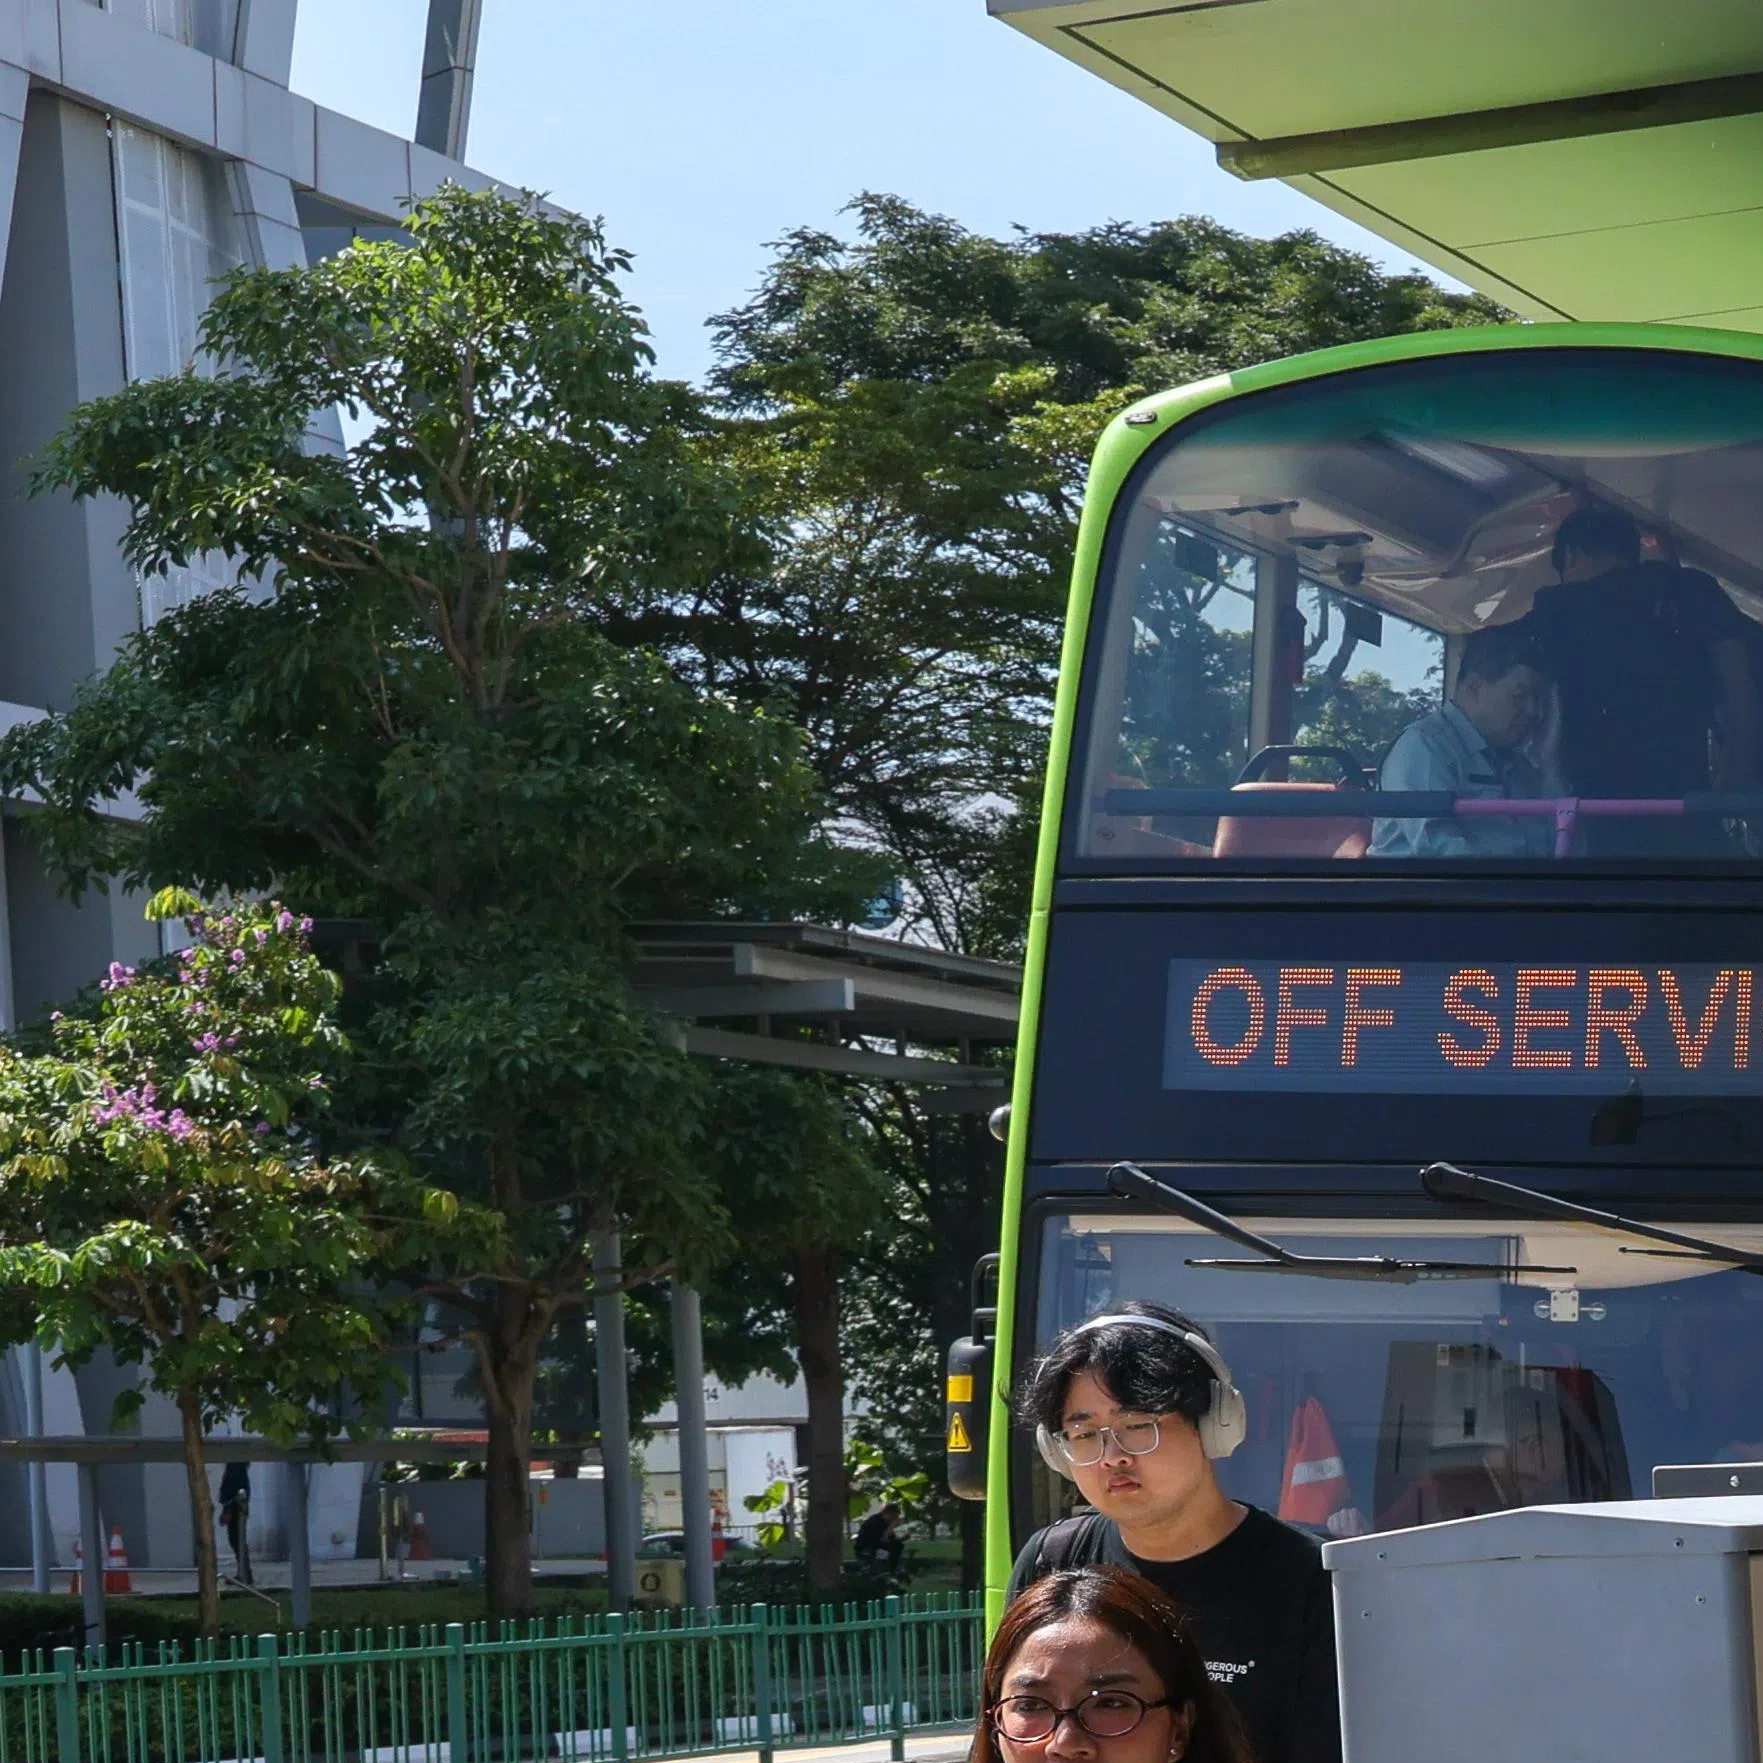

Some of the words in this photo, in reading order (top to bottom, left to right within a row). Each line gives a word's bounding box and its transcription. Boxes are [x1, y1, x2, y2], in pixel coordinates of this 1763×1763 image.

[1190, 966, 1403, 1068] OFF
[1204, 1661, 1248, 1674] GEROUS
[1208, 1672, 1234, 1682] OPLE
